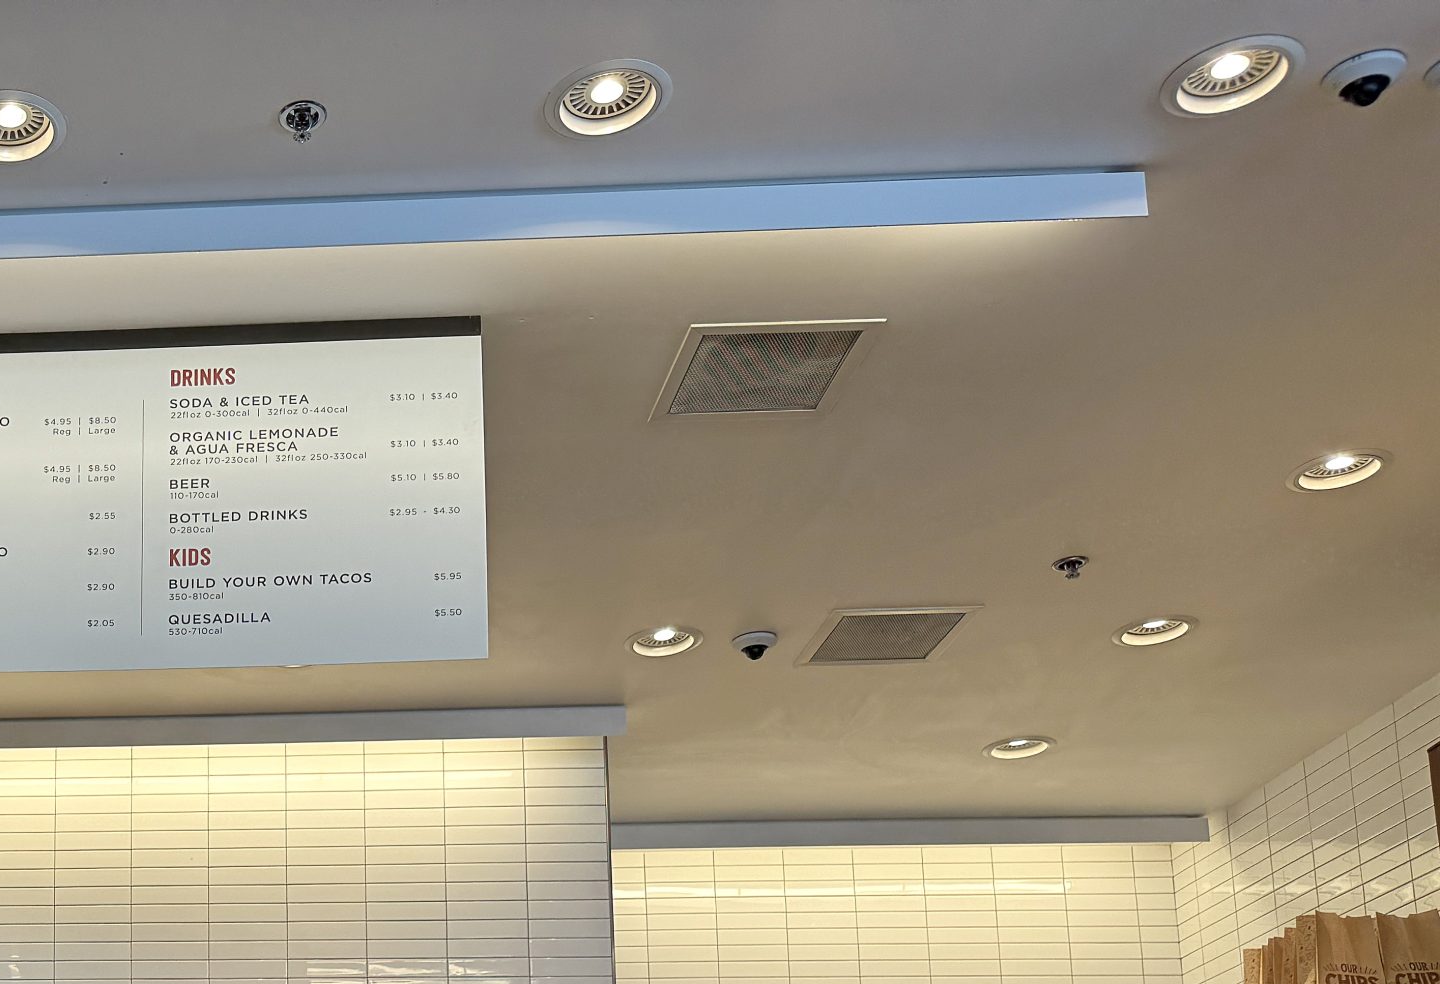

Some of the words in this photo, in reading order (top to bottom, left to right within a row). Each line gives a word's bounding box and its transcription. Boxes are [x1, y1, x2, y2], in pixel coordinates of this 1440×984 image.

[170, 368, 236, 387] DRINKS
[170, 398, 213, 409] SODA
[219, 398, 229, 407] &
[236, 396, 272, 407] ICED
[279, 394, 310, 405] TEA
[390, 392, 415, 402] $3.10
[431, 391, 458, 401] $3.40
[205, 409, 250, 418] 0-300cal
[302, 405, 348, 415] 0-440cal
[44, 417, 71, 426] $4.95
[89, 416, 116, 425] $8.50
[53, 428, 71, 437] Reg
[88, 426, 116, 436] Large
[170, 431, 242, 443] ORGANIC
[249, 427, 339, 440] LEMONADE
[390, 439, 416, 448] $3.10
[432, 438, 459, 447] $3.40
[170, 445, 179, 456] &
[185, 443, 229, 455] AGUA
[236, 441, 298, 453] FRESCA
[205, 455, 258, 465] 170-230cal
[310, 452, 367, 461] 250-330cal
[44, 465, 70, 473] $4.95
[88, 464, 116, 472] $8.50
[52, 475, 70, 484] Reg
[88, 474, 115, 483] Large
[391, 473, 416, 482] $5.10
[432, 472, 460, 481] $5.80
[169, 479, 210, 489] BEER
[170, 491, 219, 500] 110-170cal
[89, 512, 116, 520] $2.55
[169, 512, 241, 524] BOTTLED
[248, 509, 308, 521] DRINKS
[389, 507, 417, 517] $2.95
[433, 506, 460, 515] $4.30
[169, 525, 214, 534] 0-280cal
[87, 547, 115, 556] $2.90
[169, 548, 211, 567] KIDS
[169, 578, 216, 589] BUILD
[223, 577, 267, 588] YOUR
[274, 575, 313, 587] OWN
[320, 573, 372, 585] TACOS
[434, 572, 462, 581] $5.95
[87, 583, 115, 591] $2.90
[169, 592, 224, 601] 350-810cal
[434, 608, 462, 617] $5.50
[87, 619, 115, 627] $2.05
[168, 612, 271, 626] QUESADILLA
[168, 626, 223, 636] 530-710cal
[1341, 964, 1357, 973] OUR
